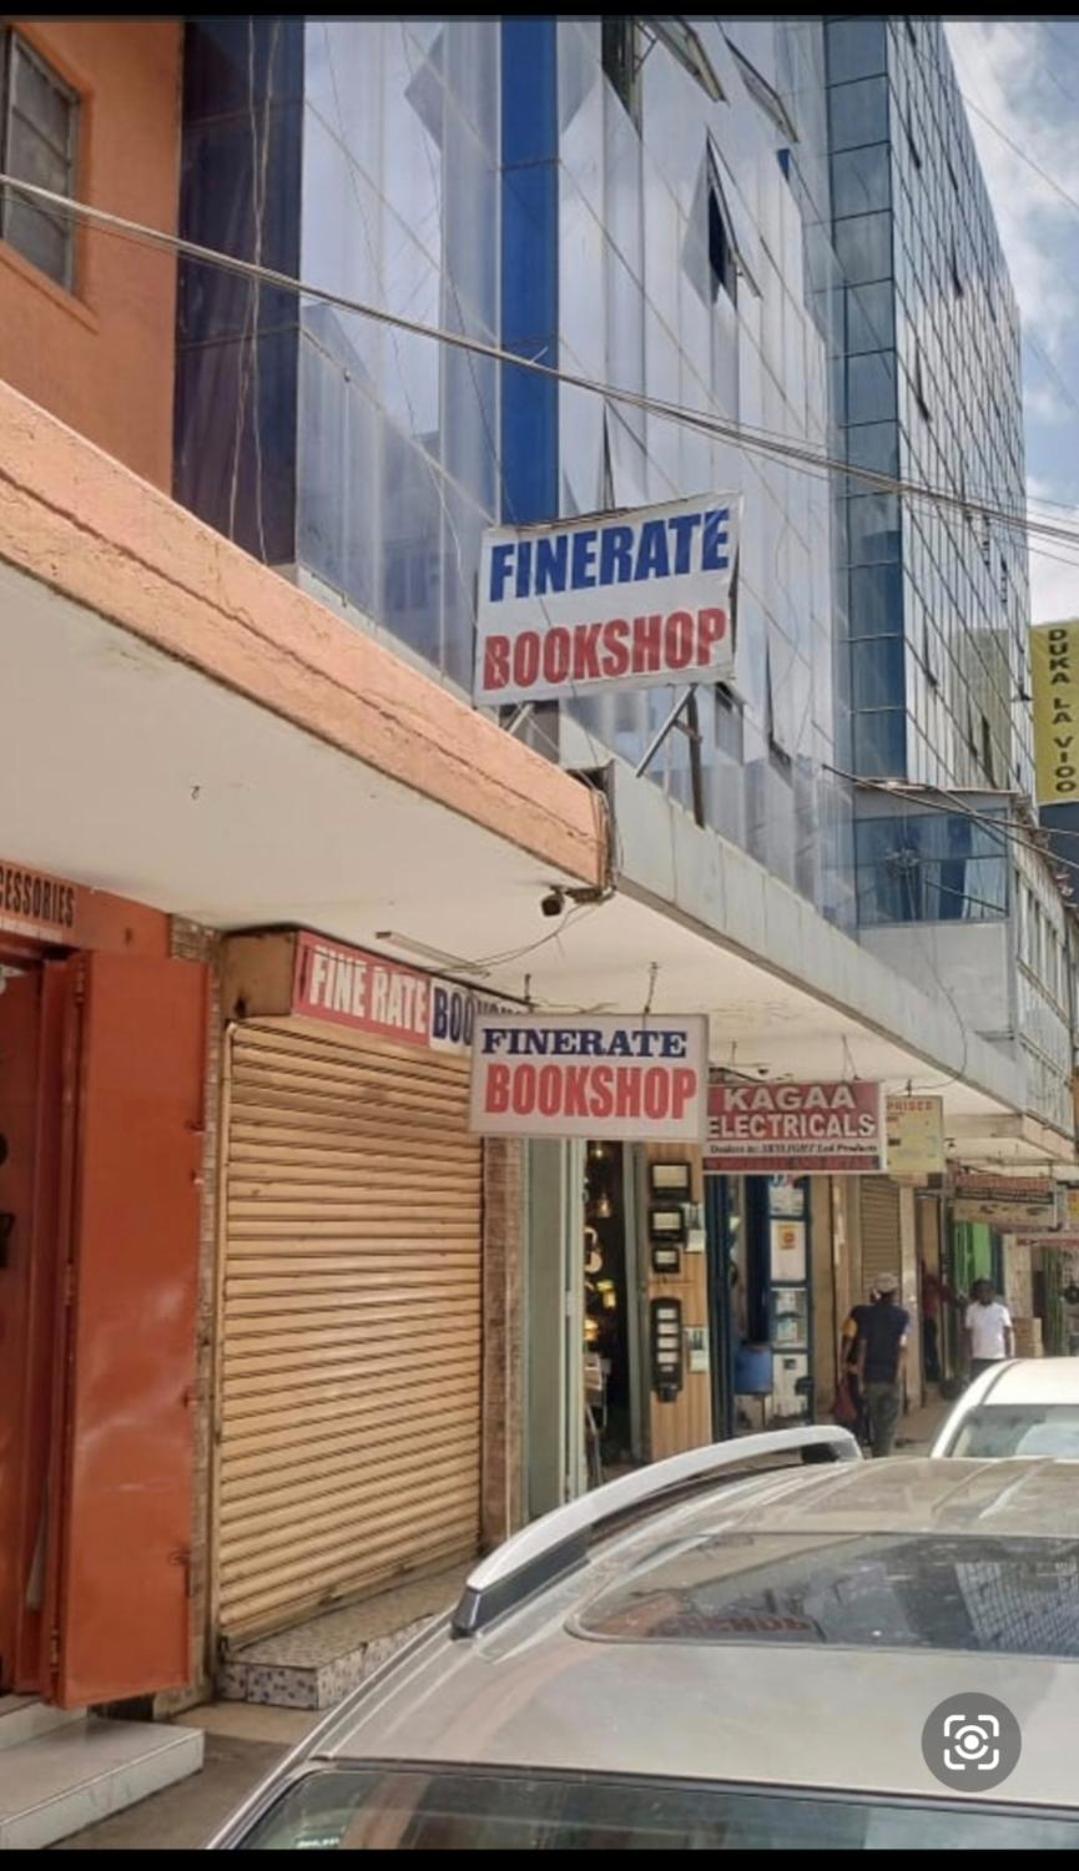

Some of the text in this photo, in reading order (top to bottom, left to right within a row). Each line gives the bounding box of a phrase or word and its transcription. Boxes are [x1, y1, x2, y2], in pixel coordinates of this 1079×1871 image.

[490, 508, 729, 602] FINERATE
[483, 608, 727, 691] BOOKSHOP
[1049, 629, 1077, 792] DUKA LA VIOO
[310, 945, 367, 1018] FINE
[371, 966, 427, 1034] RATE
[481, 1028, 687, 1058] FINERATE
[485, 1063, 697, 1119] BOOKSHOP
[706, 1114, 876, 1137] ELECTRICALS
[724, 1087, 855, 1111] KAGAA
